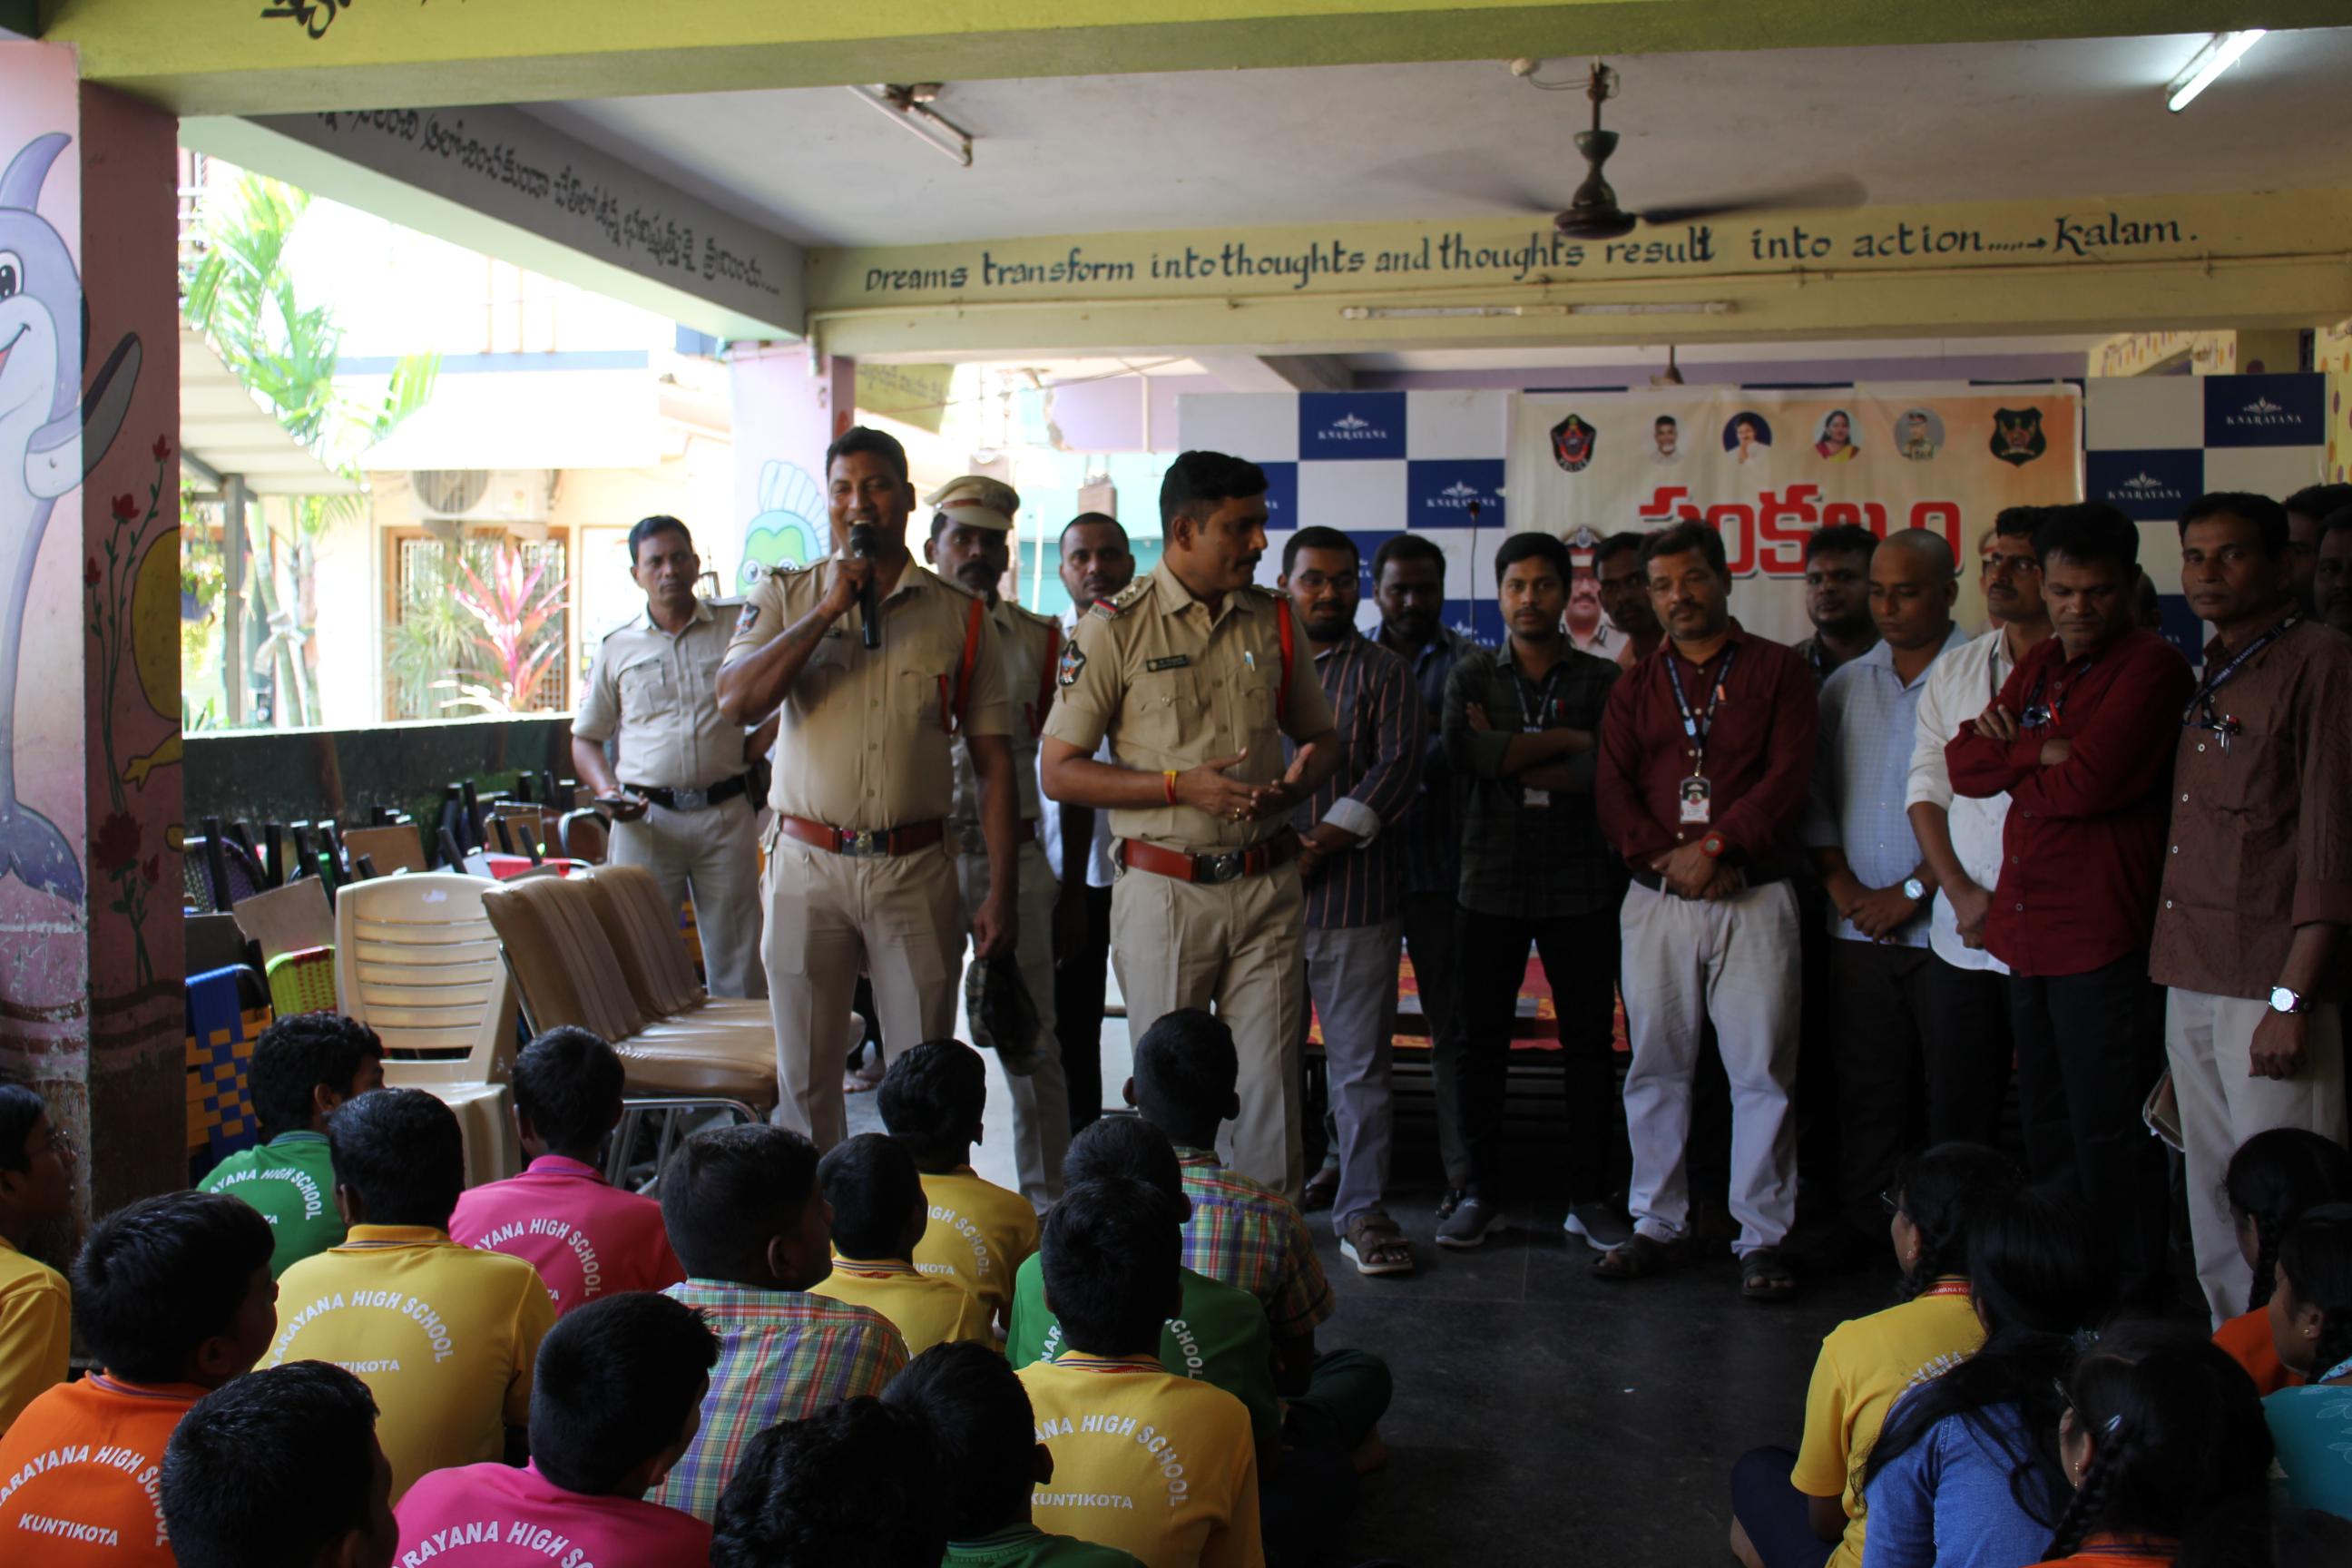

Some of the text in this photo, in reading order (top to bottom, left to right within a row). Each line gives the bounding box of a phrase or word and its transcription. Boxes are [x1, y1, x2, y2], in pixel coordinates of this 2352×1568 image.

[982, 246, 1135, 287] transform
[1151, 247, 1216, 279] into
[1220, 240, 1366, 290] thoughts
[1374, 235, 1430, 273] and
[1438, 229, 1585, 281] thoughts
[1606, 225, 1715, 264] result
[1750, 226, 1832, 260] into
[260, 1167, 298, 1180] HIGH
[290, 1170, 323, 1220] SCHOOL
[529, 1218, 571, 1240] HIGH
[567, 1230, 602, 1298] SCHOOL
[955, 1217, 991, 1277] SCHOOL
[350, 1290, 403, 1309] HIGH
[402, 1297, 455, 1363] SCHOOL
[1163, 1316, 1204, 1378] CHOOL
[0, 1445, 90, 1508] ARAYANA
[93, 1445, 145, 1475] HIGH
[1081, 1413, 1138, 1437] HIGH
[1136, 1425, 1191, 1508] SCHOOL
[18, 1513, 120, 1548] KUNTIKOTA
[505, 1520, 571, 1558] HIGH
